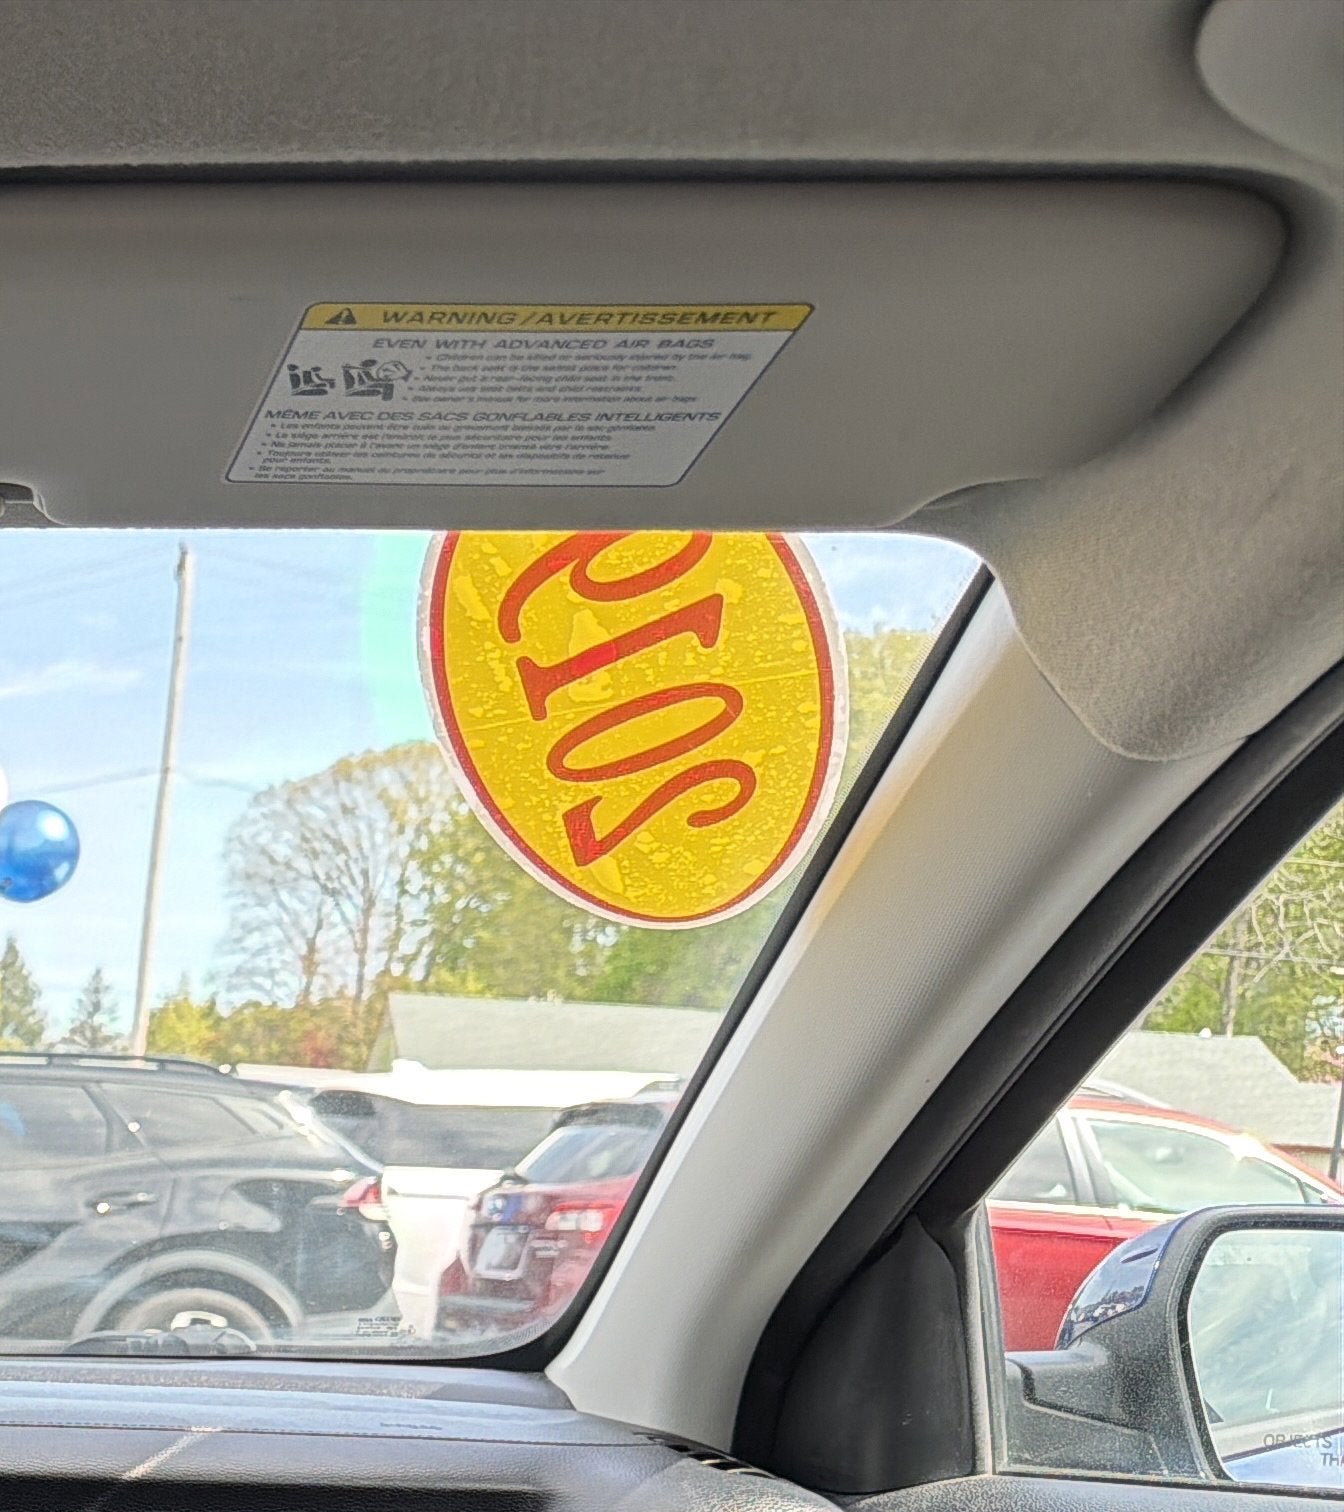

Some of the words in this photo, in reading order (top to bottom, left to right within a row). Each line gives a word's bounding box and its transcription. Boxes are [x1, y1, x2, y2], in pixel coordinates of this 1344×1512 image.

[382, 310, 516, 326] WARNING
[372, 338, 427, 349] EVEN
[435, 339, 487, 349] WITH
[494, 339, 607, 350] ADVANCED
[615, 339, 649, 349] AIR
[658, 338, 715, 349] BAGS
[324, 410, 373, 421] AVEC
[376, 411, 413, 421] DES
[417, 411, 468, 421] SACS
[1264, 1434, 1332, 1448] OBJECTS
